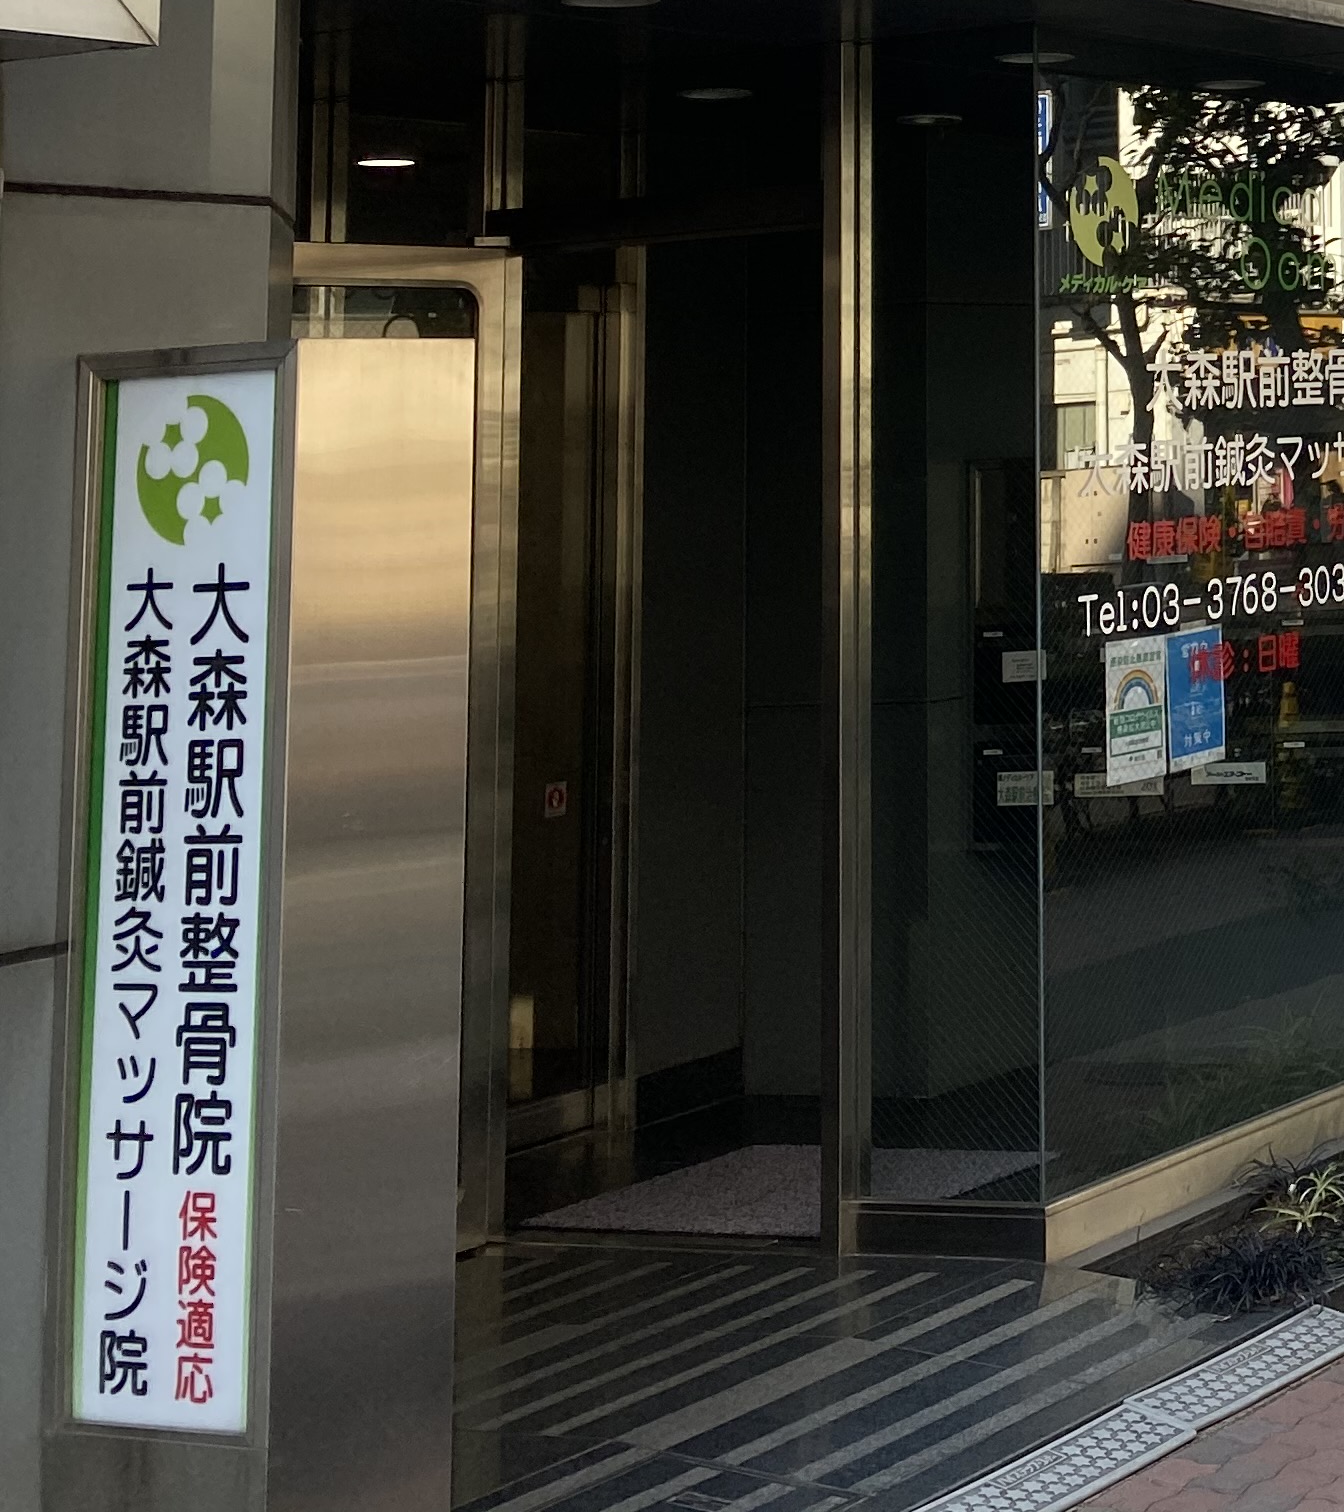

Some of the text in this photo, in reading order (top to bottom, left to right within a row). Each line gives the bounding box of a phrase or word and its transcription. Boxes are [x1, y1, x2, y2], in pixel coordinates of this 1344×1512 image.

[1157, 168, 1334, 228] Medical
[99, 567, 174, 1396] 大森駅前鍼灸マッサージ院
[172, 562, 250, 1404] 大森駅前整骨院 保険適応
